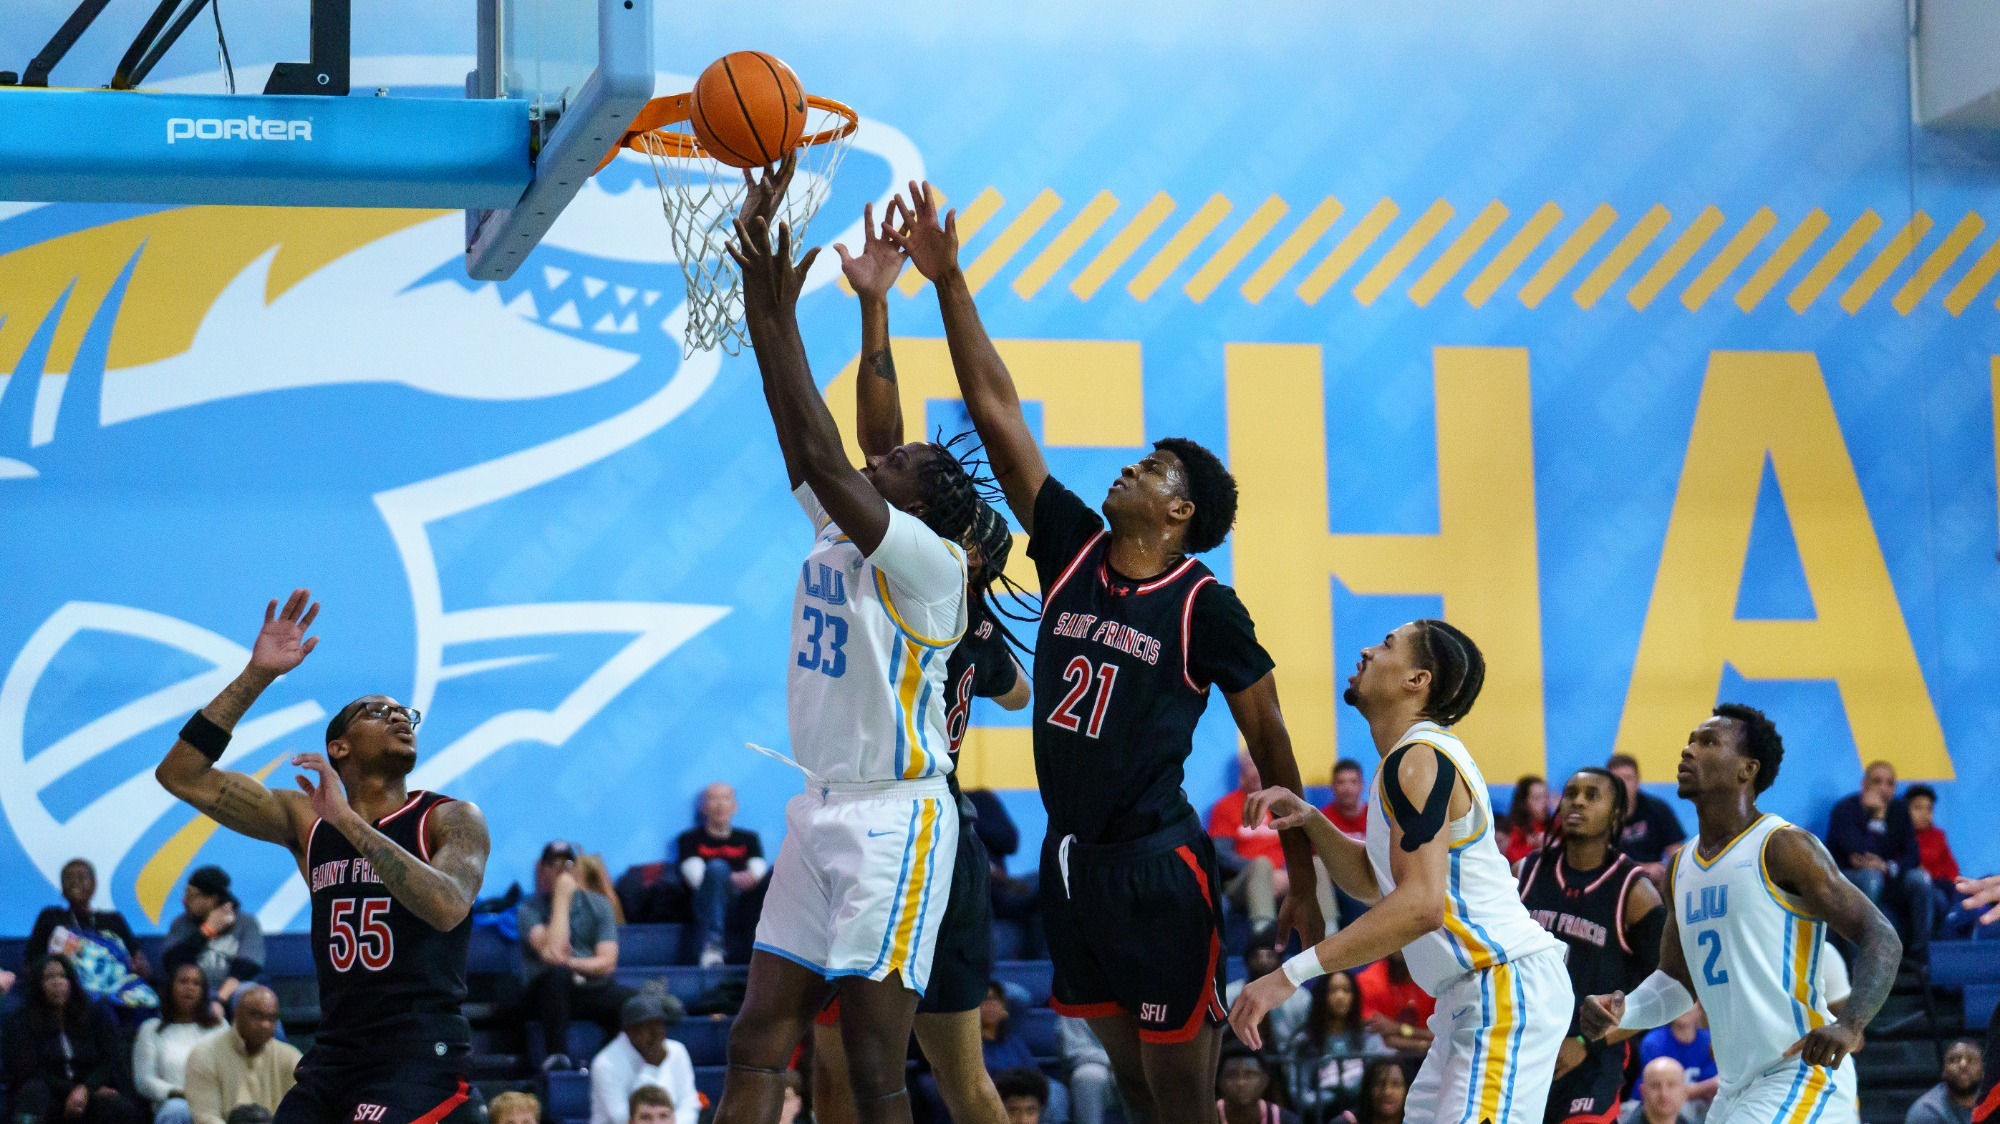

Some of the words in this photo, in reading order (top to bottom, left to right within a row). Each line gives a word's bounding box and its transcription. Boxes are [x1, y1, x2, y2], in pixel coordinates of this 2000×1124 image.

[802, 560, 847, 605] LIU
[797, 605, 849, 679] 33
[1053, 612, 1098, 639] SAINT
[1092, 620, 1161, 666] FRANCIS
[1046, 655, 1119, 739] 21
[312, 860, 350, 893] SAINT
[1685, 884, 1728, 925] LIU
[329, 896, 395, 973] 55
[1556, 912, 1607, 947] FRANCIS
[1697, 929, 1730, 987] 2
[1140, 1002, 1168, 1022] SFU
[353, 1103, 387, 1122] SFU
[1568, 1097, 1595, 1114] SFU
